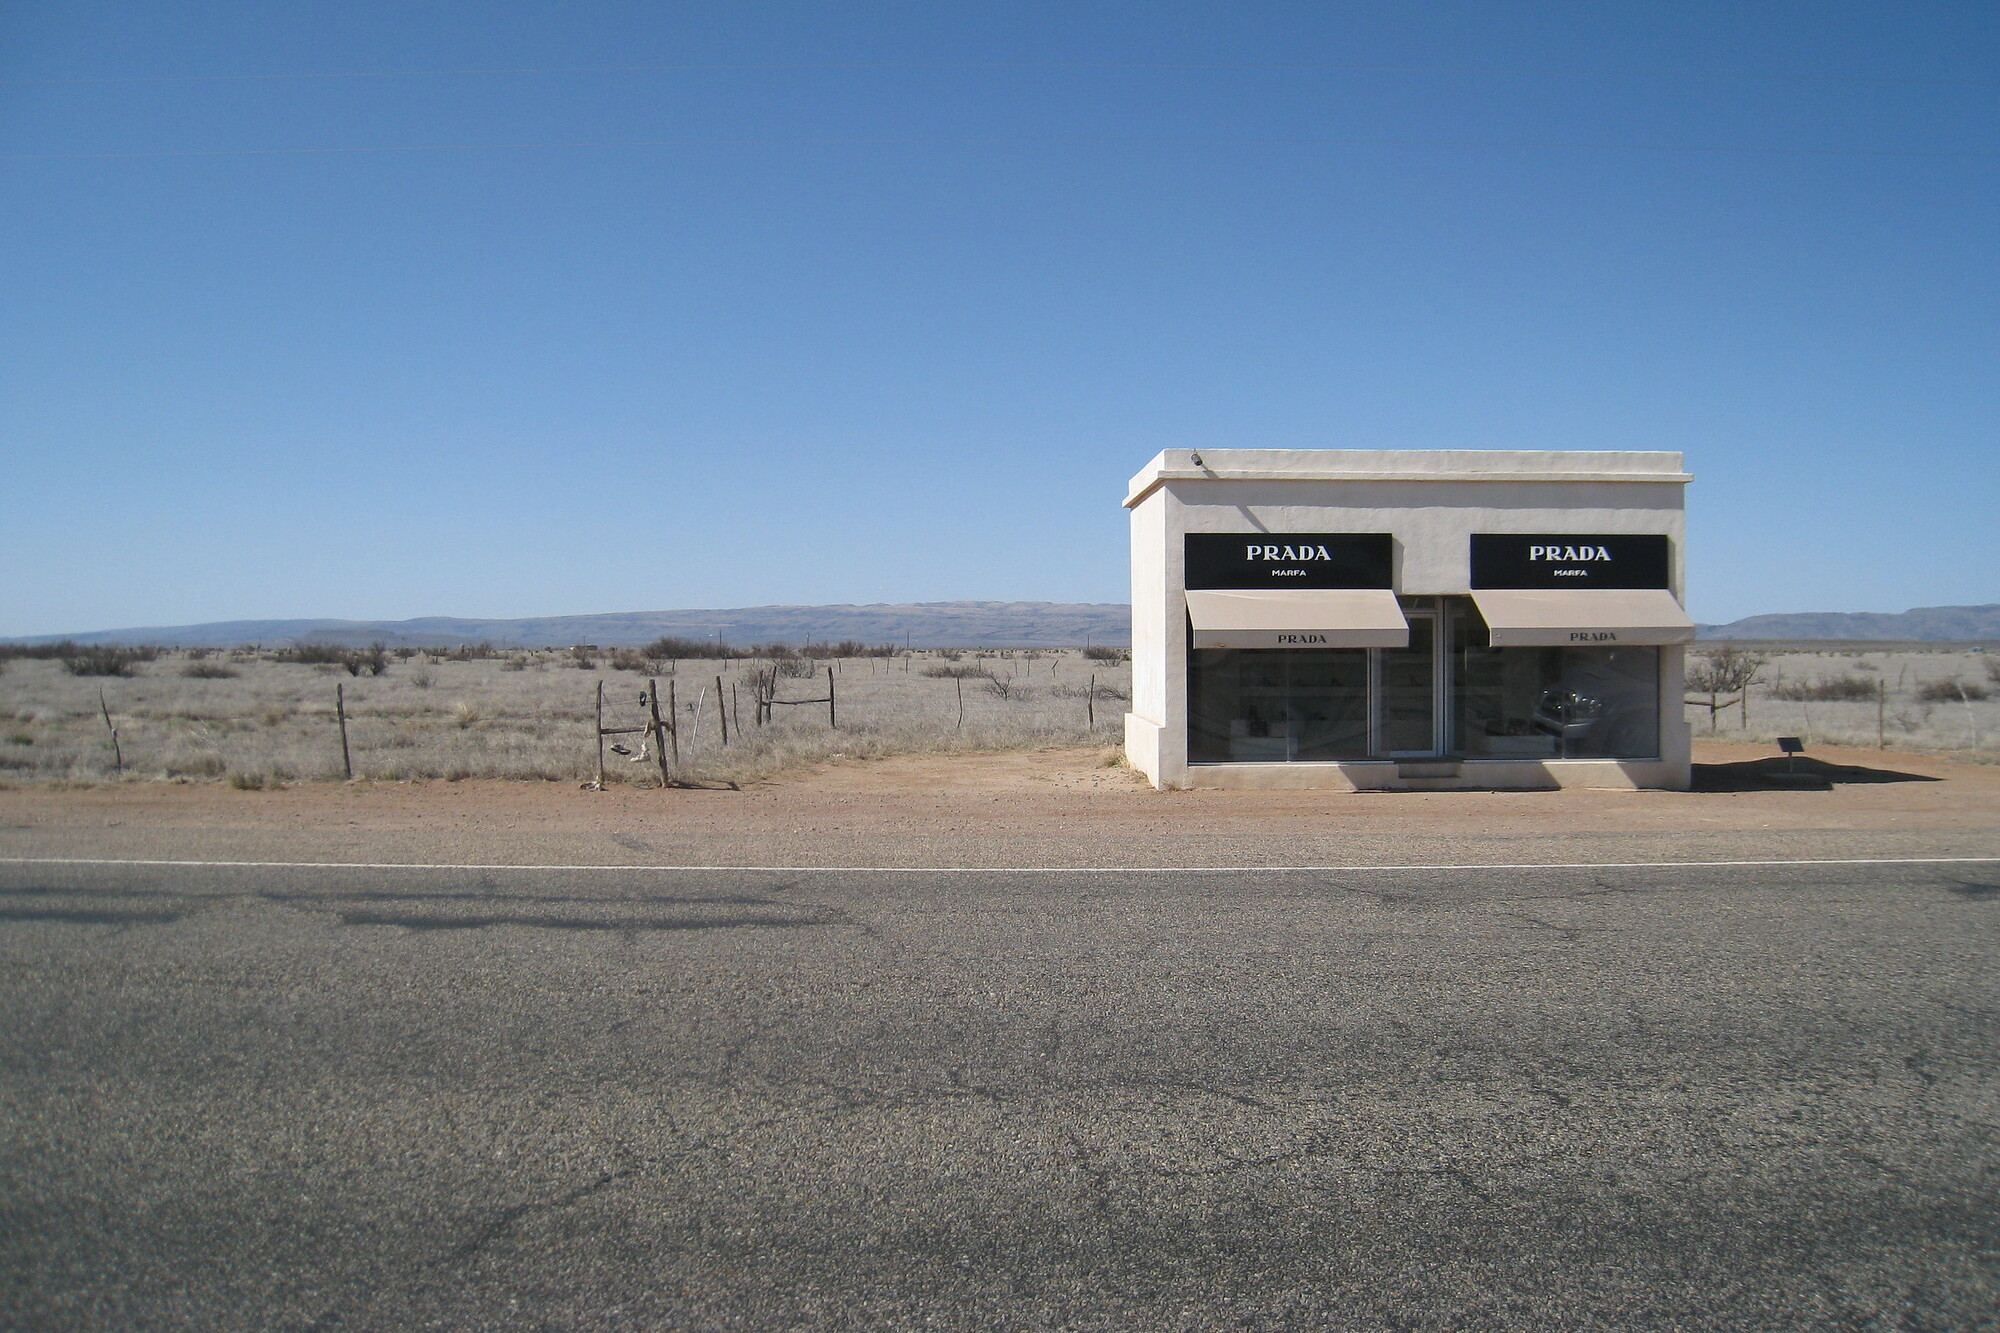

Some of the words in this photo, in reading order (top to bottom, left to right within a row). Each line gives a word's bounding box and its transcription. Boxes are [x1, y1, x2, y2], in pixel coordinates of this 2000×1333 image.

[1246, 545, 1332, 561] PRADA
[1529, 546, 1612, 561] PRADA
[1271, 569, 1307, 577] MARFA
[1553, 569, 1588, 577] MARFA
[1277, 634, 1327, 644] PRADA
[1569, 632, 1616, 641] PRADA
